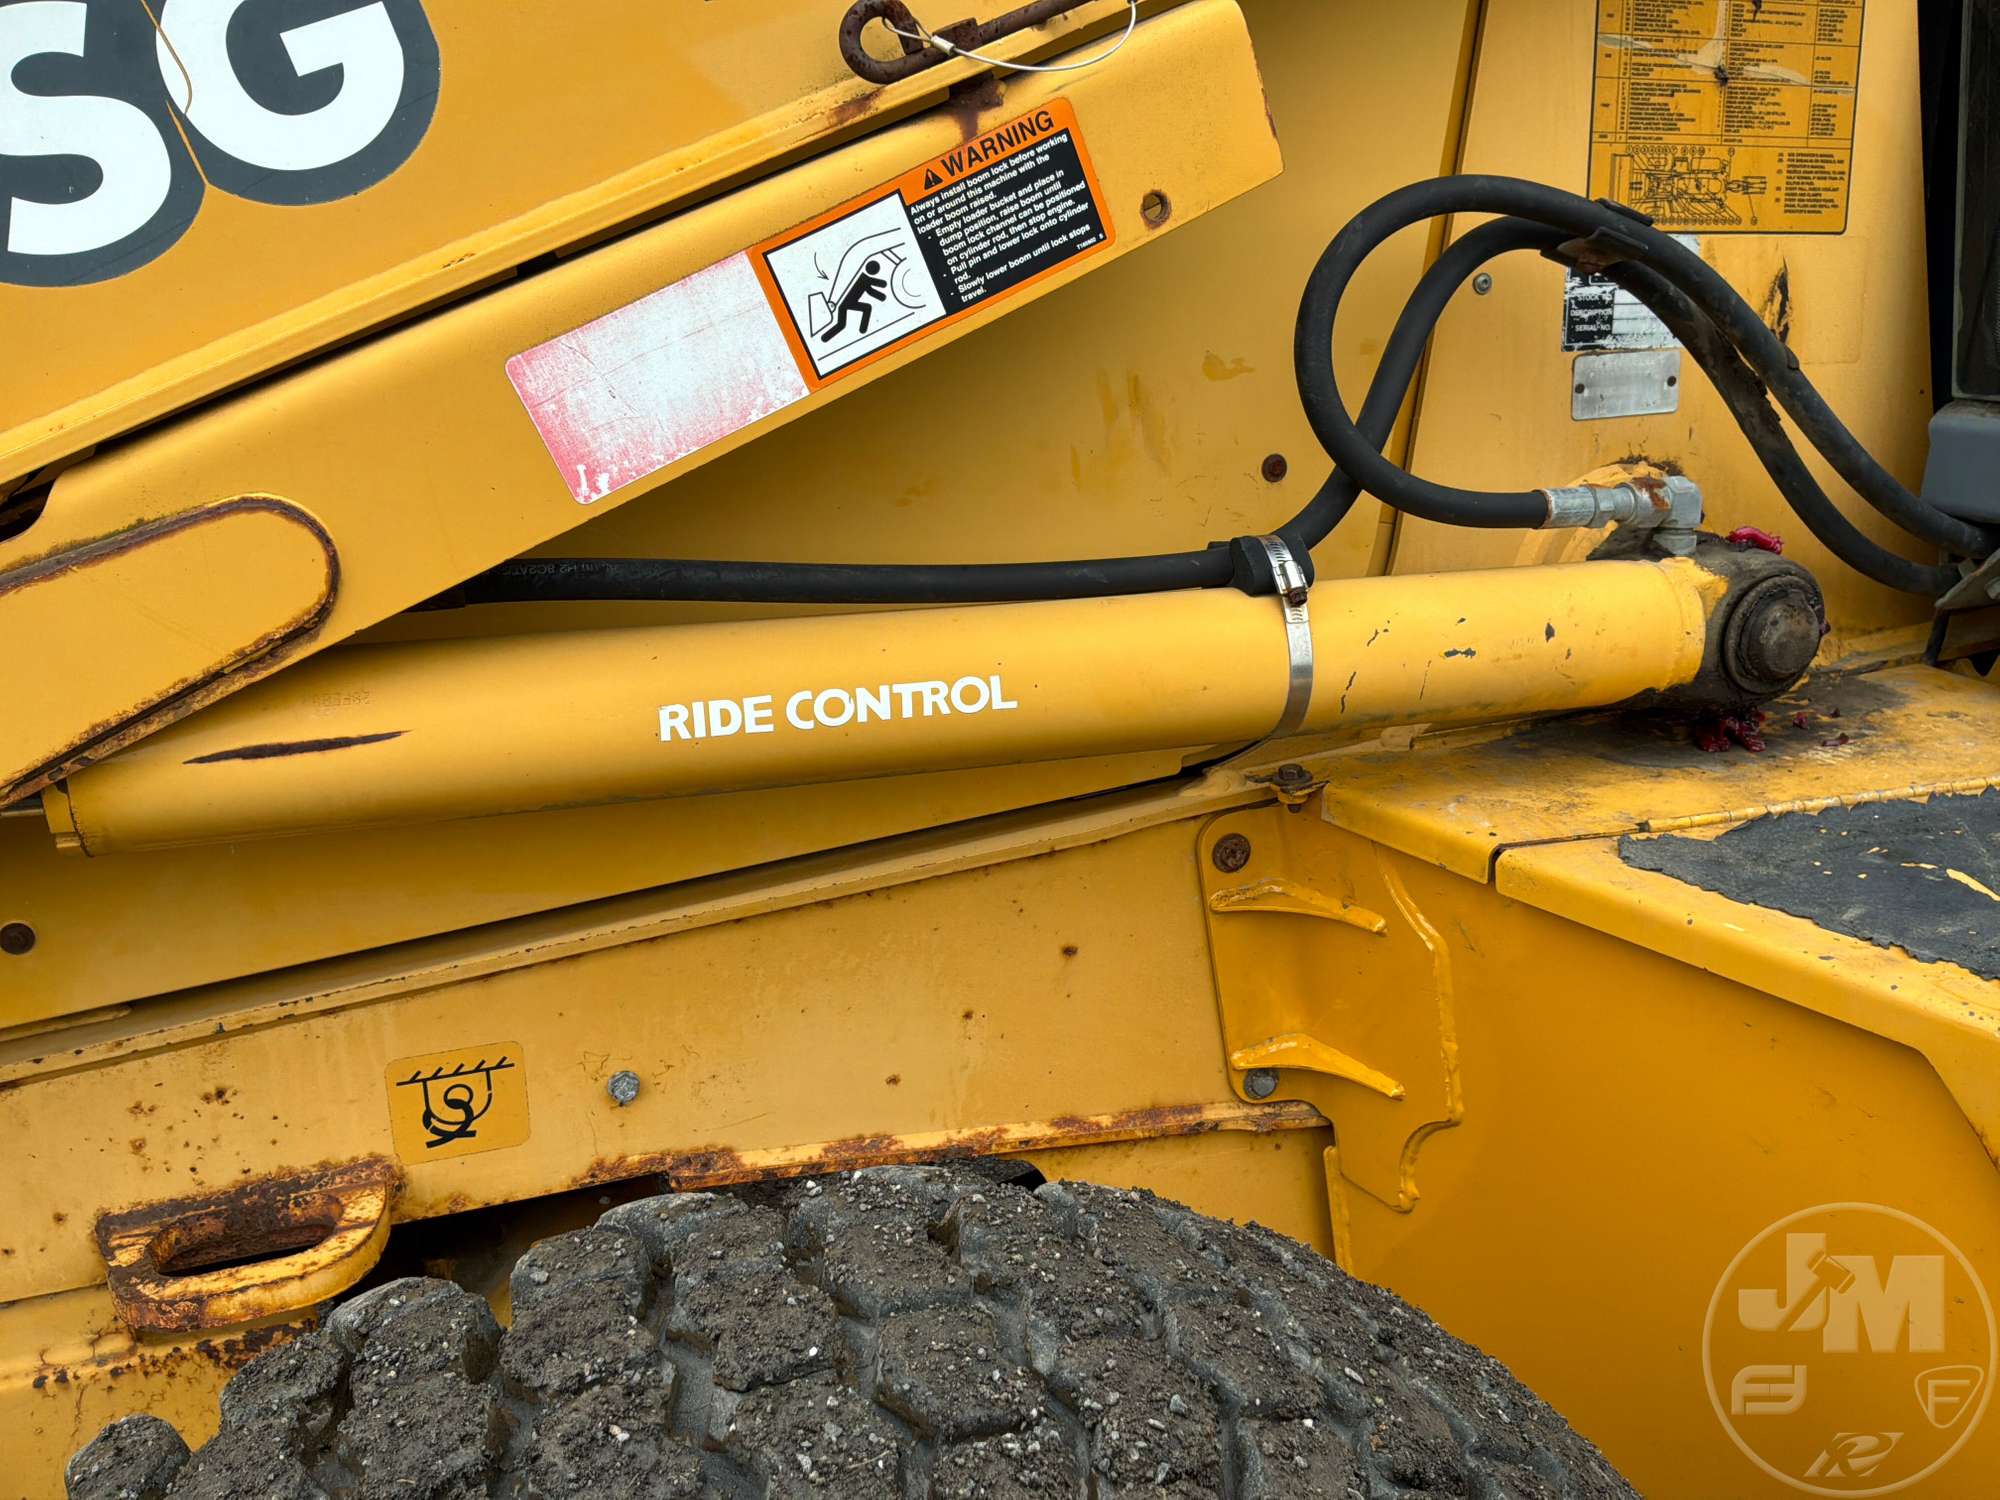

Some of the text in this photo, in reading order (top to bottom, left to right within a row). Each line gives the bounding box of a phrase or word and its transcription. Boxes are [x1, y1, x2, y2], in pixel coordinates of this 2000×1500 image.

[910, 133, 1068, 215] Always install boom lock before working
[941, 110, 1054, 176] WARNING
[913, 153, 1050, 224] on or around this machine with the
[916, 190, 997, 234] loader boom raised.
[935, 169, 1064, 237] Empty loader bucket and place in
[939, 180, 1062, 246] dump position, raise boom until
[942, 180, 1086, 256] boom lock channel can be positioned
[946, 199, 1075, 265] on cylinder rod, then stop engine.
[950, 202, 1088, 274] Pull pin and lower lock onto cylinder
[958, 275, 984, 293] Slowly
[985, 264, 1007, 280] lower
[1008, 253, 1032, 268] boom
[1032, 242, 1050, 256] until
[1050, 234, 1068, 247] lock
[1068, 224, 1090, 239] stops
[954, 271, 971, 284] rod.
[961, 285, 987, 302] travel.
[658, 675, 1018, 741] RIDE CONTROL
